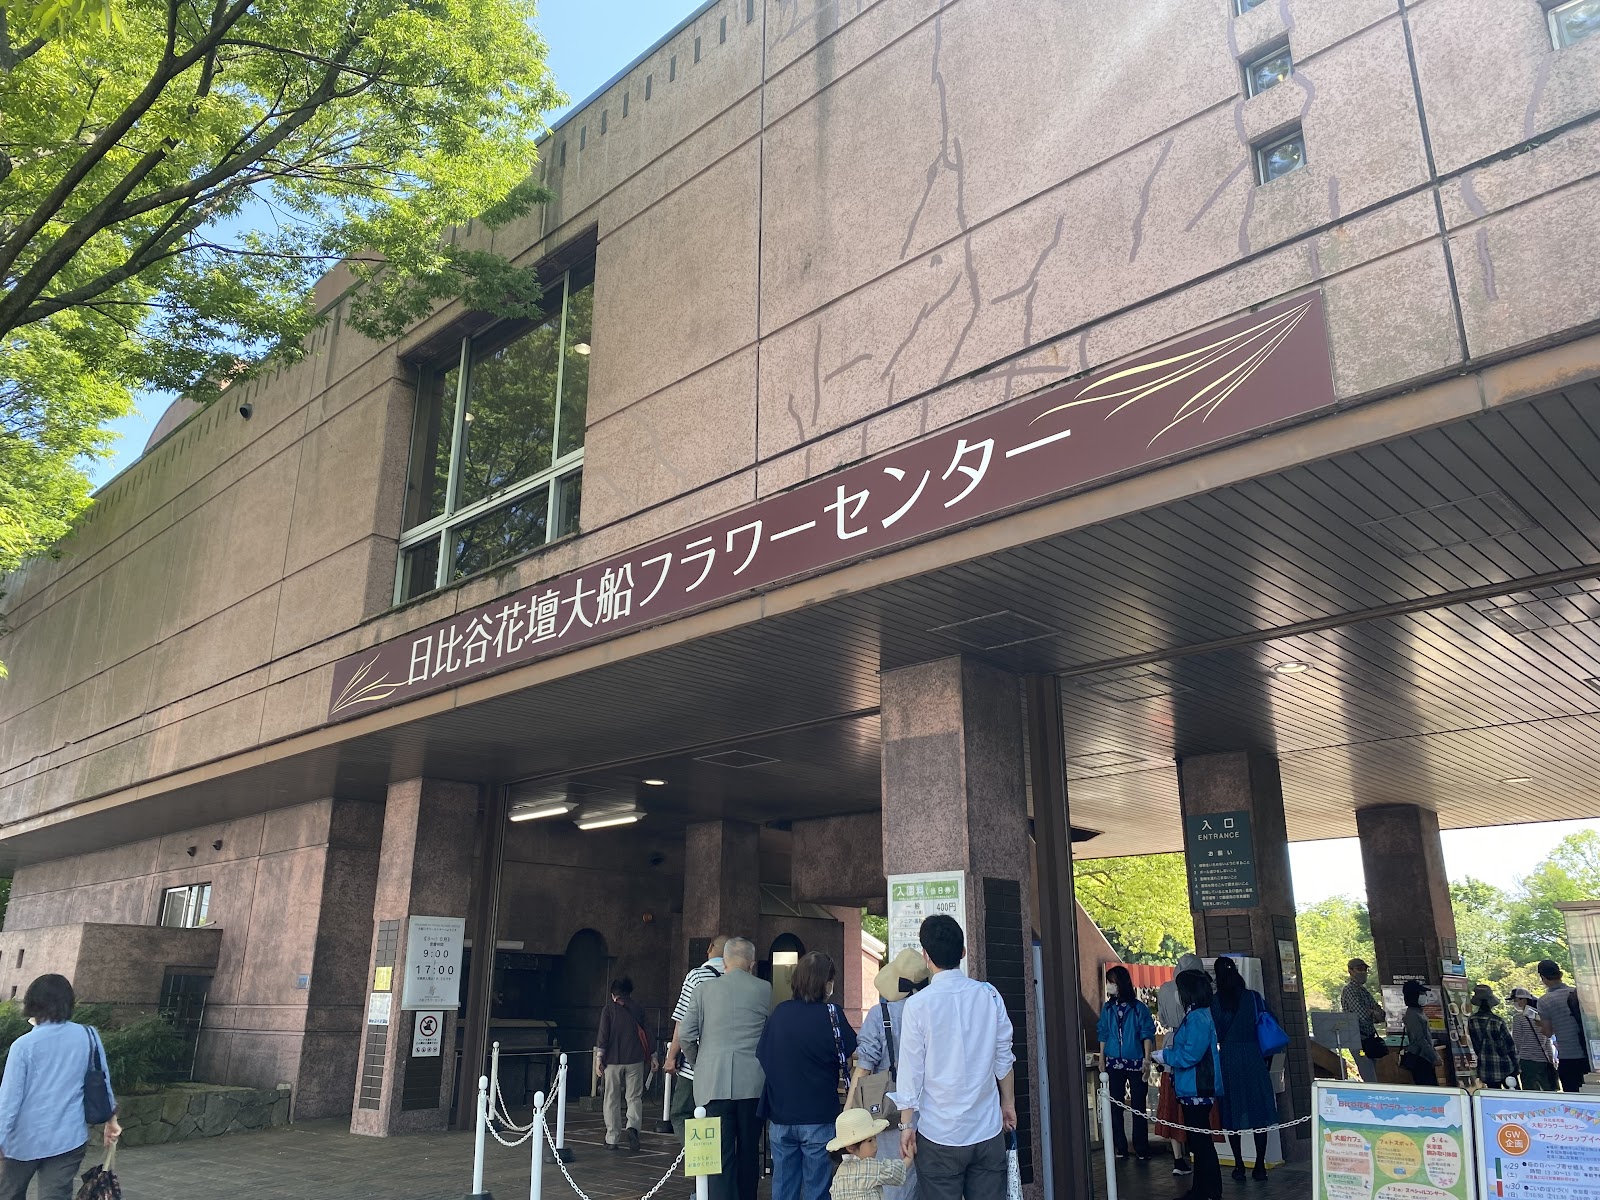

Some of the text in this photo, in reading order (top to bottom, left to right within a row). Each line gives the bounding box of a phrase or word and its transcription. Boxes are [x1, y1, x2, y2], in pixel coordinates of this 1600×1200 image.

[406, 428, 1073, 687] 日比谷花壇大船フラワーセンター
[1202, 818, 1234, 831] 入口
[1198, 832, 1240, 841] ENTRANCE
[937, 903, 957, 912] 400円
[416, 965, 454, 975] 17:00
[691, 1128, 715, 1140] 入口
[1505, 1139, 1523, 1148] 企画
[1503, 1162, 1519, 1170] 4/29
